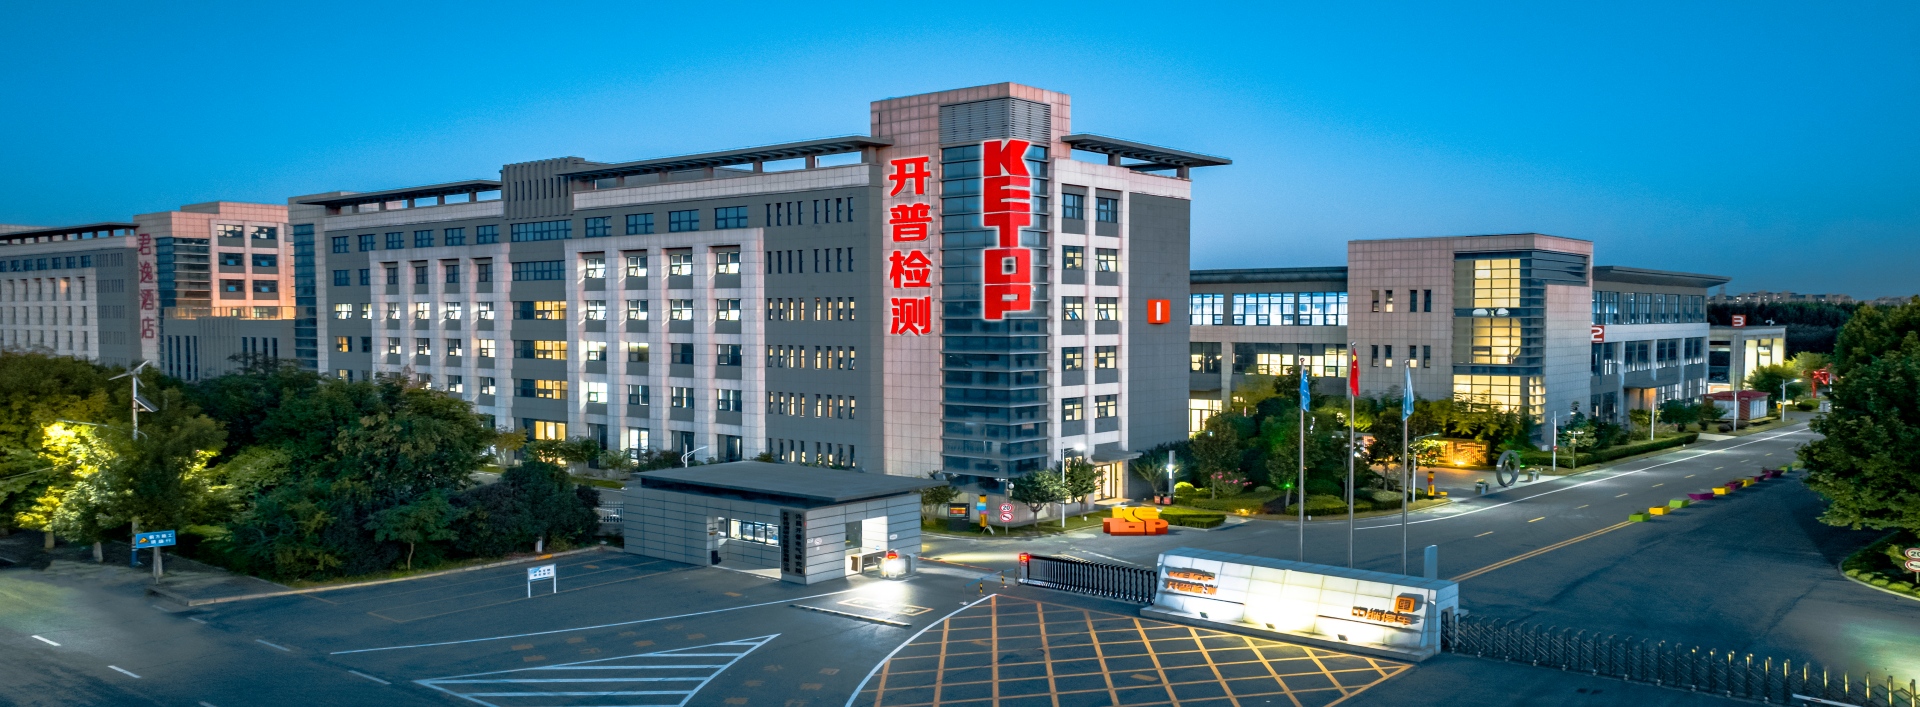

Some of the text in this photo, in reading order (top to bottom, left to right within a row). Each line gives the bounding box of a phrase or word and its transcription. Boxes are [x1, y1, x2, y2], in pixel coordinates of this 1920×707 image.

[888, 156, 932, 336] 开普检测
[984, 139, 1031, 320] KETOP
[138, 233, 154, 339] 君逸酒店
[1591, 326, 1603, 341] 2
[1733, 315, 1744, 327] 3
